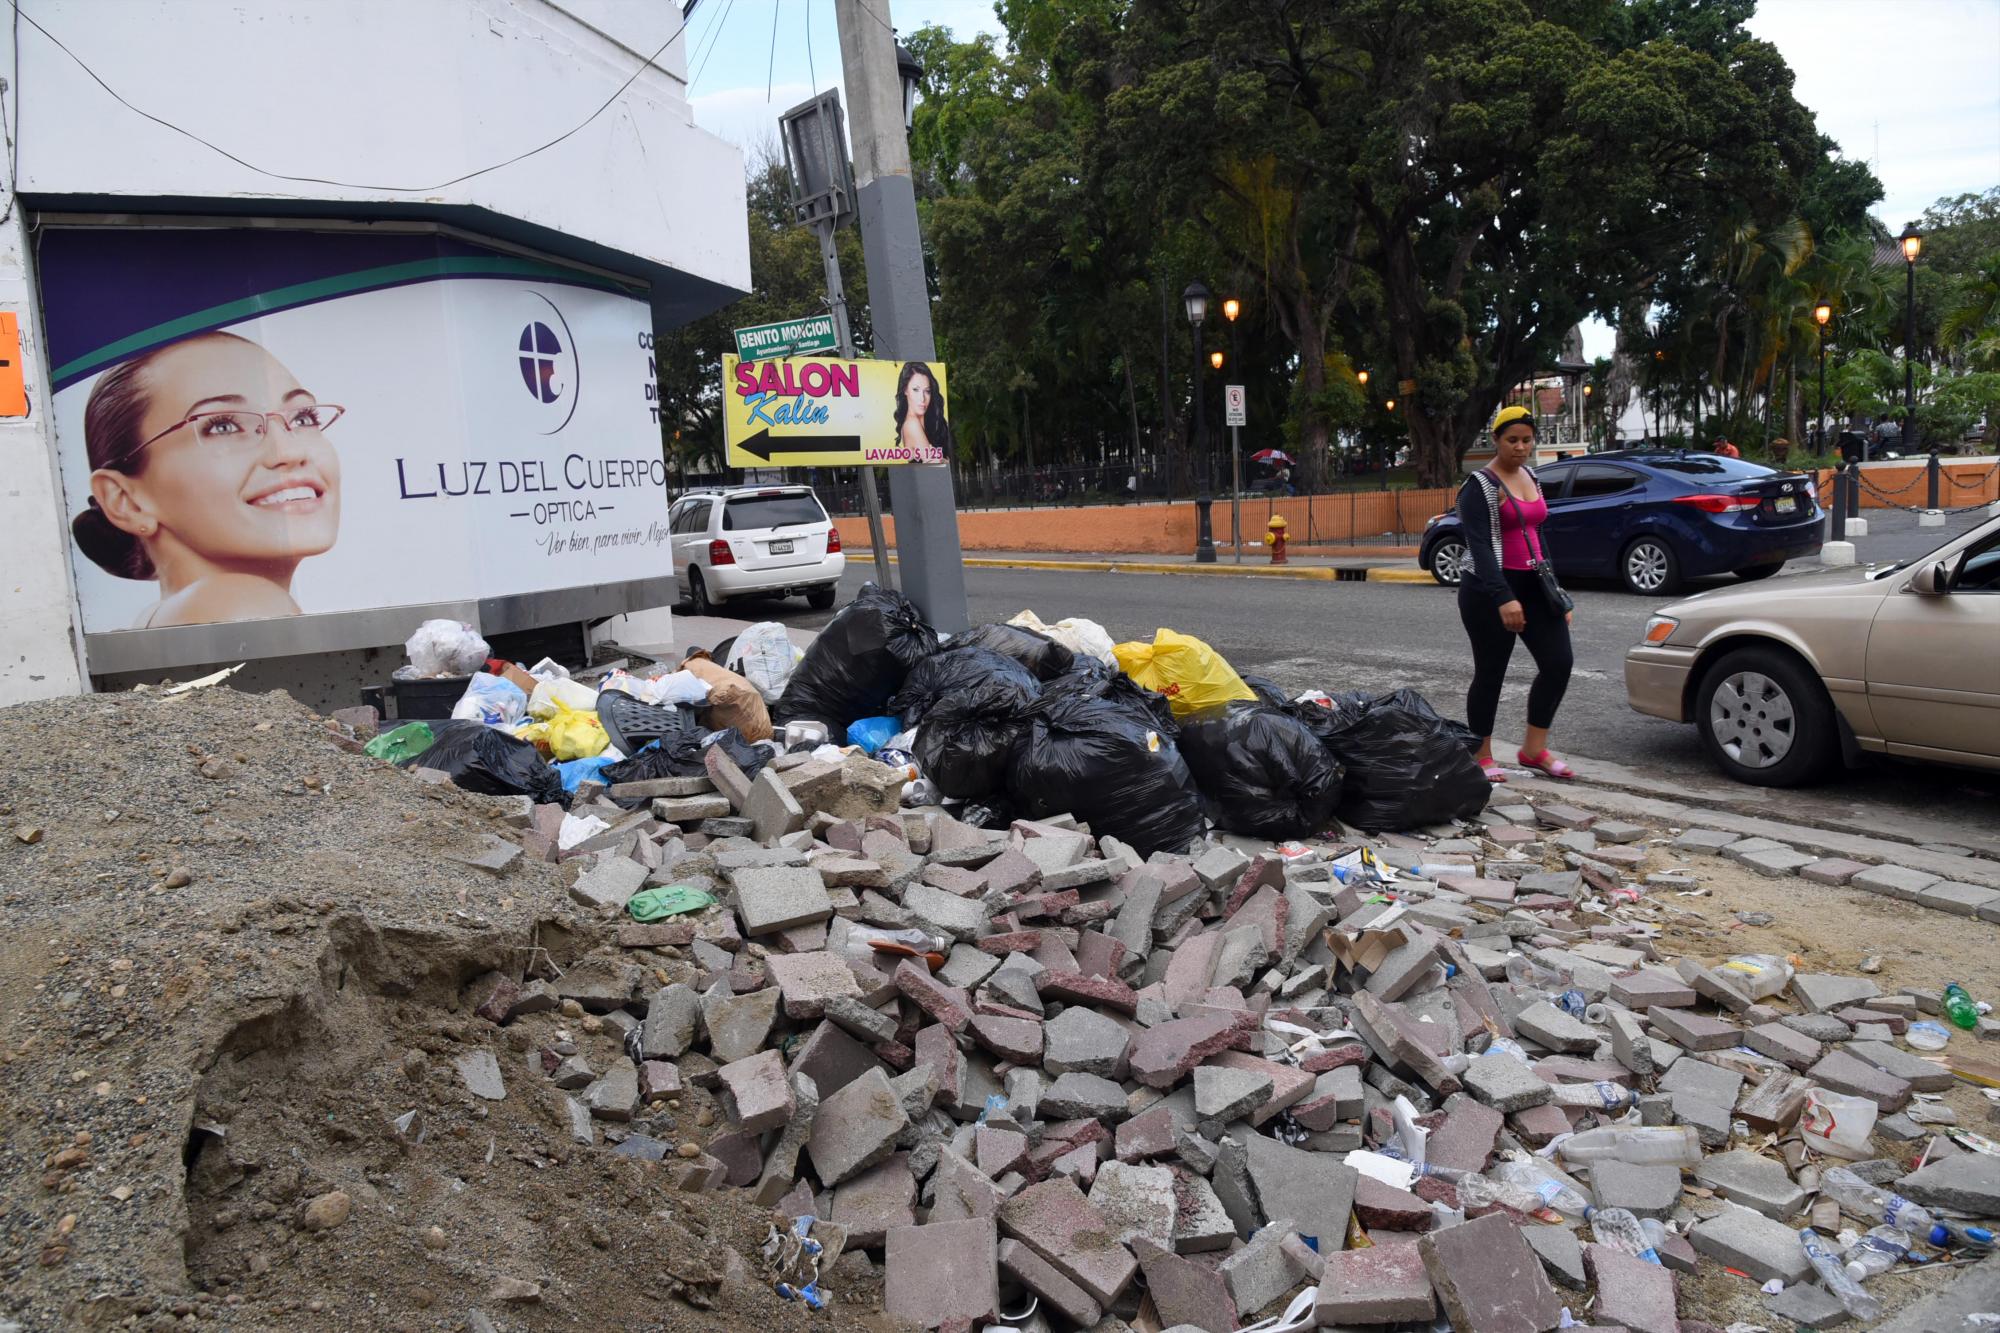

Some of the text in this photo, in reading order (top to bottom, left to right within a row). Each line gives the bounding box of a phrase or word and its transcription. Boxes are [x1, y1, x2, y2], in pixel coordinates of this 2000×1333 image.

[738, 327, 779, 349] BENITO
[781, 320, 831, 342] MONCION
[735, 362, 860, 398] SALON
[743, 391, 830, 427] Kalin
[865, 448, 912, 461] LAVADO
[924, 447, 944, 460] 125
[395, 453, 667, 500] LUZ DEL CUERPO
[533, 500, 597, 525] OPTICA
[535, 531, 567, 556] Ver
[593, 533, 619, 556] para
